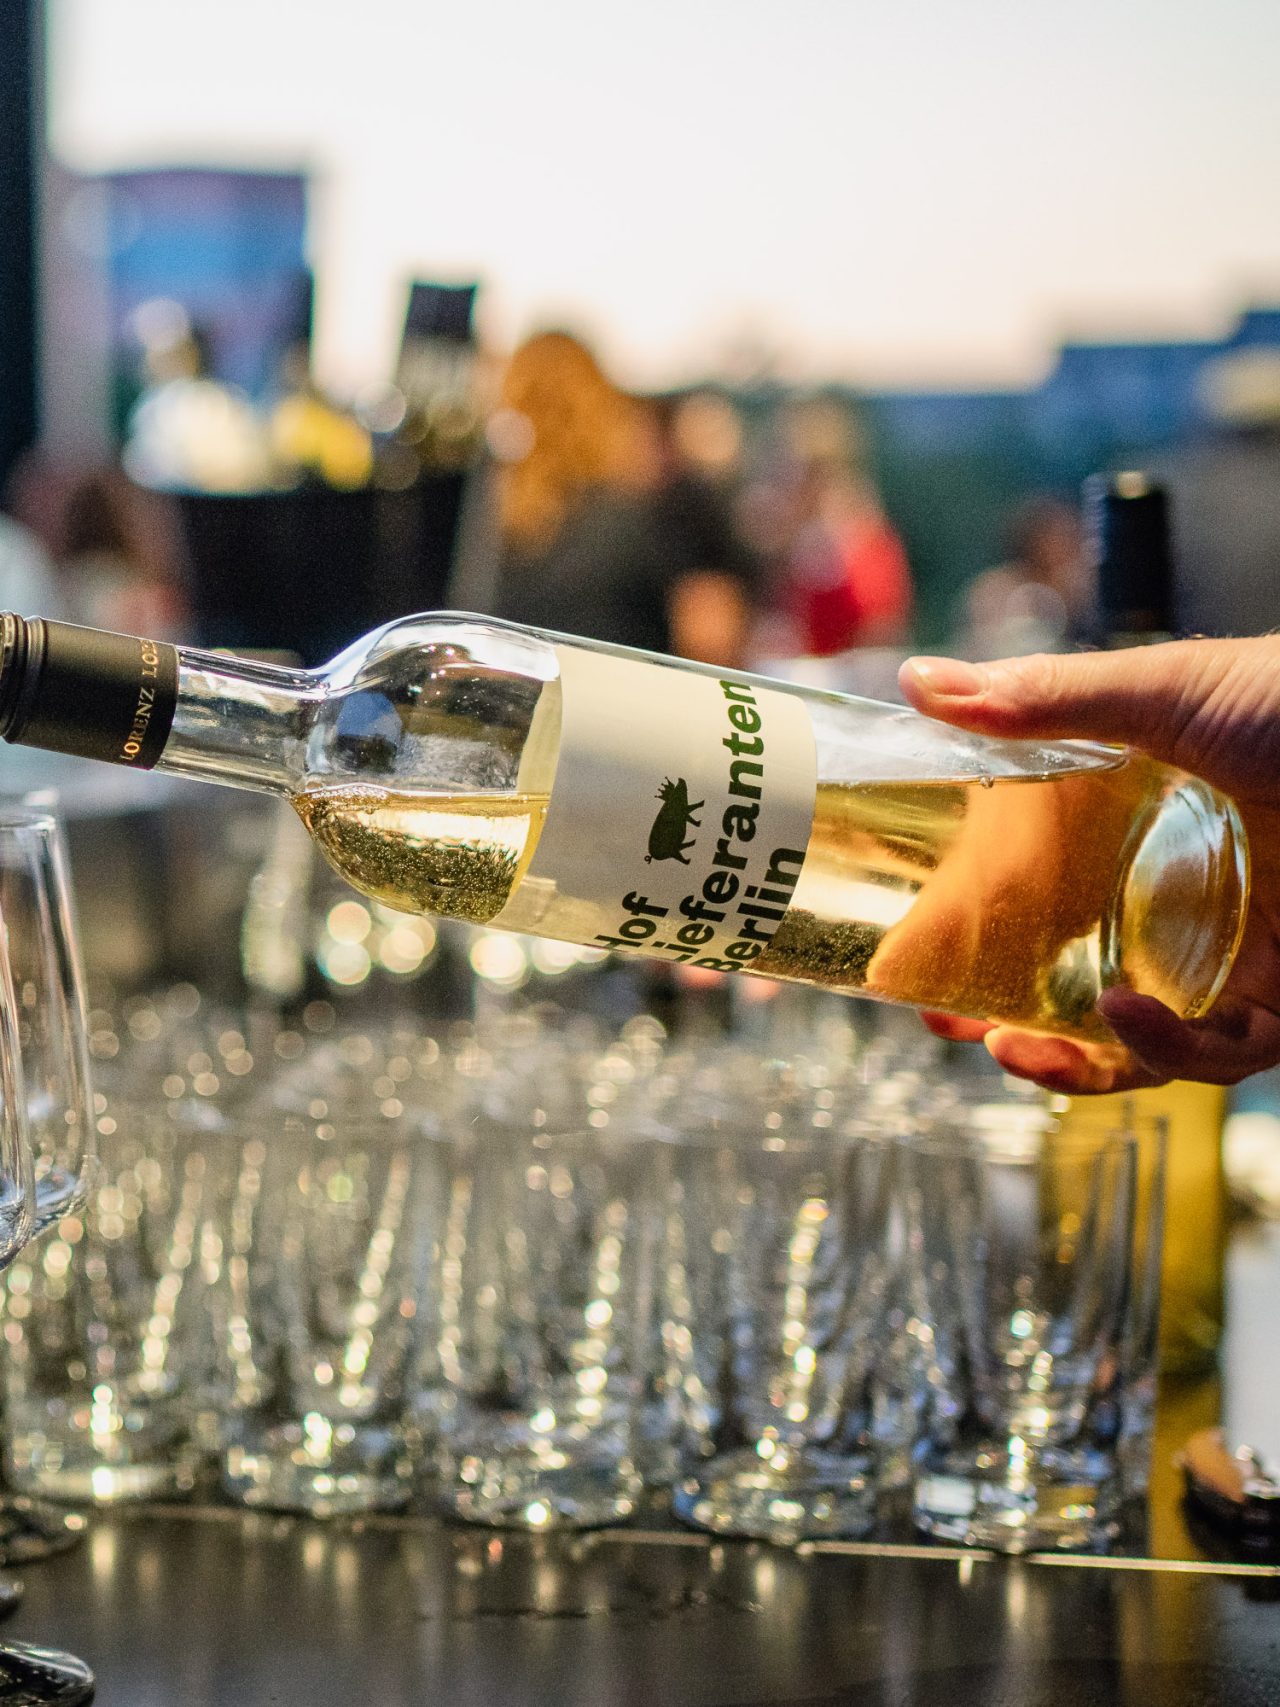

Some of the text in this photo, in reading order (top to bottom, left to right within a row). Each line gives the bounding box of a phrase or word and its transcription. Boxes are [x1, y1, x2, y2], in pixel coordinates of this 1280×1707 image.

[120, 687, 154, 760] LORENZ
[584, 891, 670, 952] Hof
[690, 847, 806, 972] Berlin
